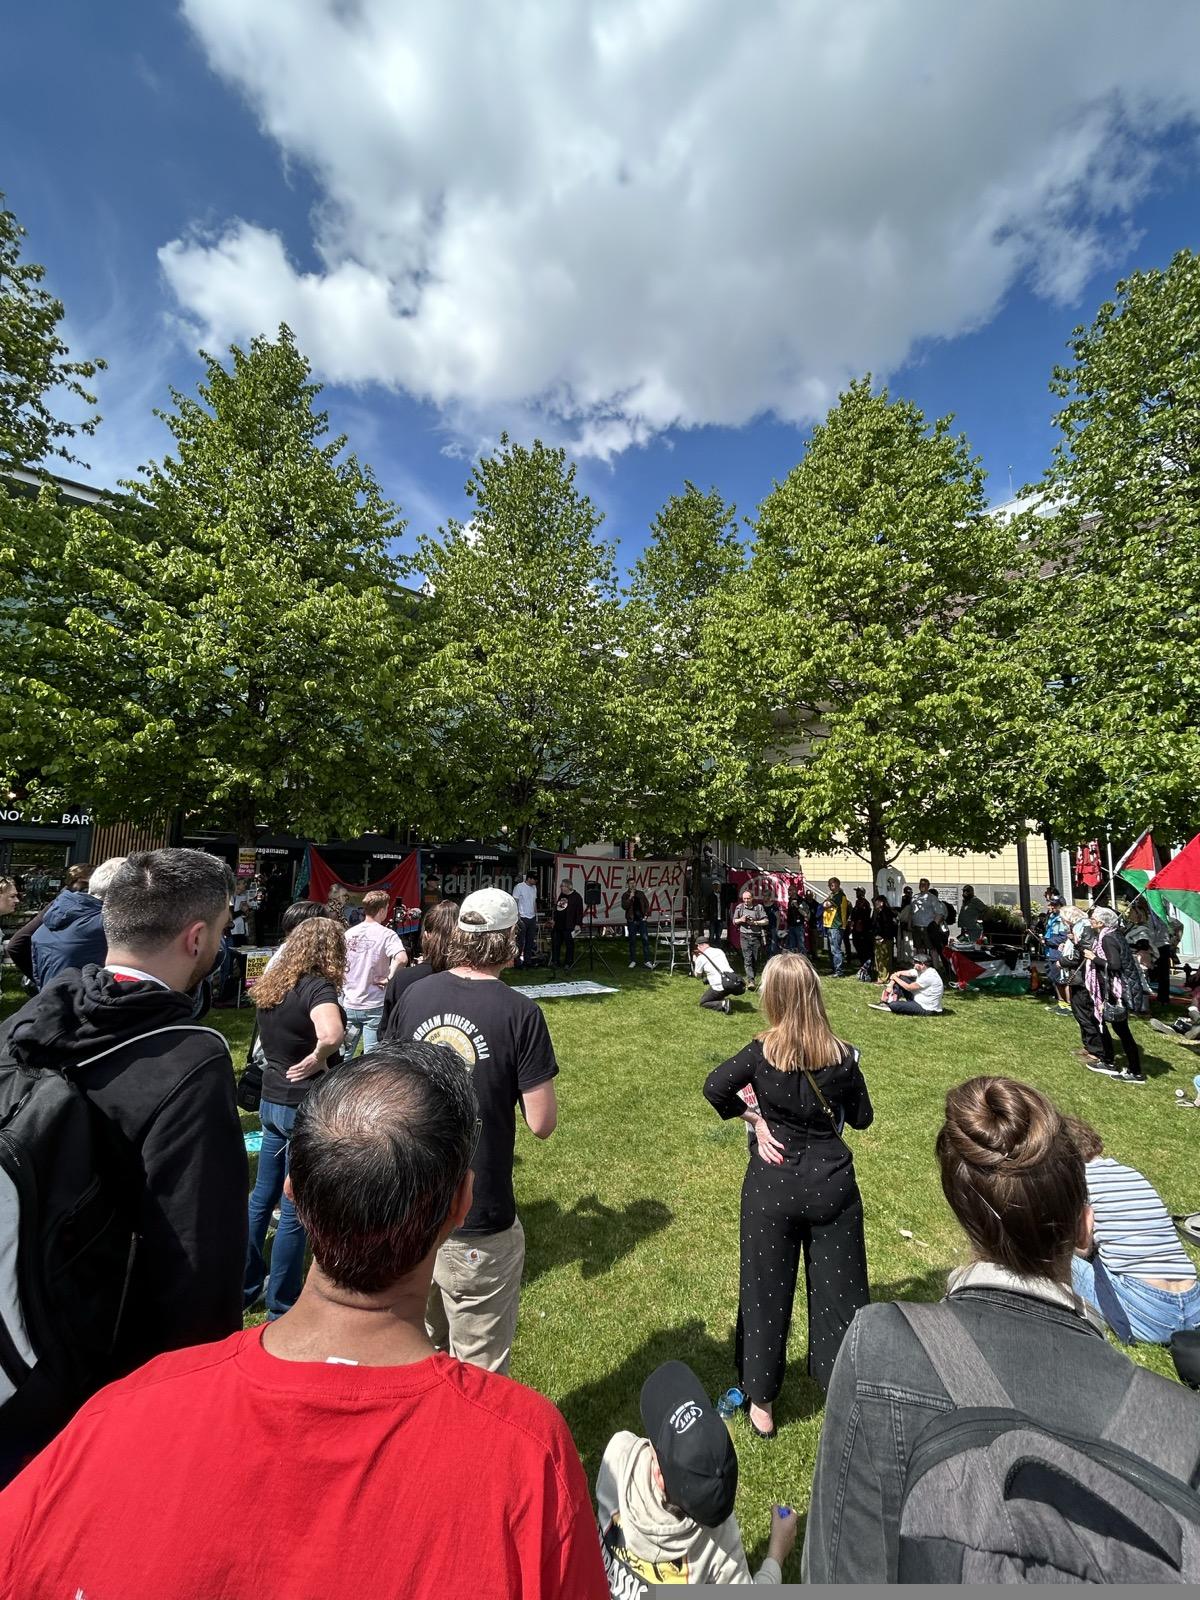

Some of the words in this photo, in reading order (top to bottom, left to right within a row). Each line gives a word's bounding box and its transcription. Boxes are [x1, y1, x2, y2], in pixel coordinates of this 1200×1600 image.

[62, 813, 90, 826] BAR
[373, 853, 402, 861] wagamama
[563, 864, 624, 889] TYNE
[413, 1015, 442, 1041] URHAM
[443, 1013, 479, 1035] MINERS'
[472, 1034, 491, 1060] GALA
